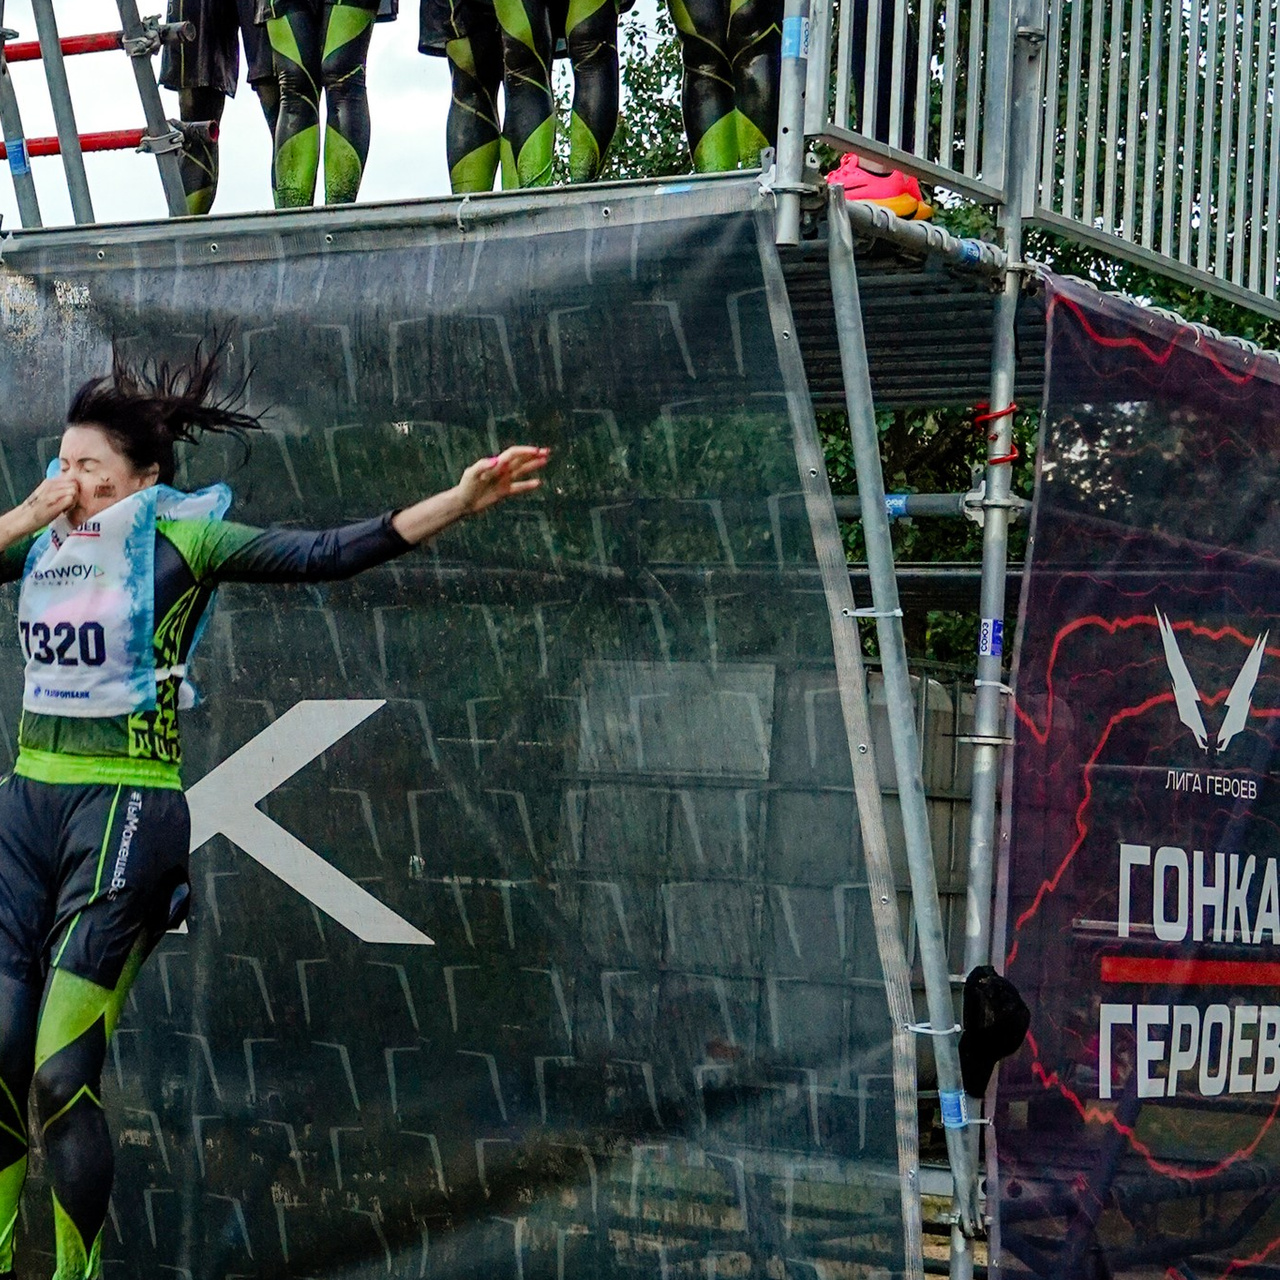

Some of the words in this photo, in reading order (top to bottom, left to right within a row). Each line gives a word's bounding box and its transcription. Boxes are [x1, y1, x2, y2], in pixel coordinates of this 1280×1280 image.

[1165, 770, 1203, 794] ЛИГА
[1206, 775, 1258, 800] ГЕРОЕВ
[1117, 843, 1280, 946] ГОНКА
[1099, 1004, 1280, 1099] ГЕРОЕВ
